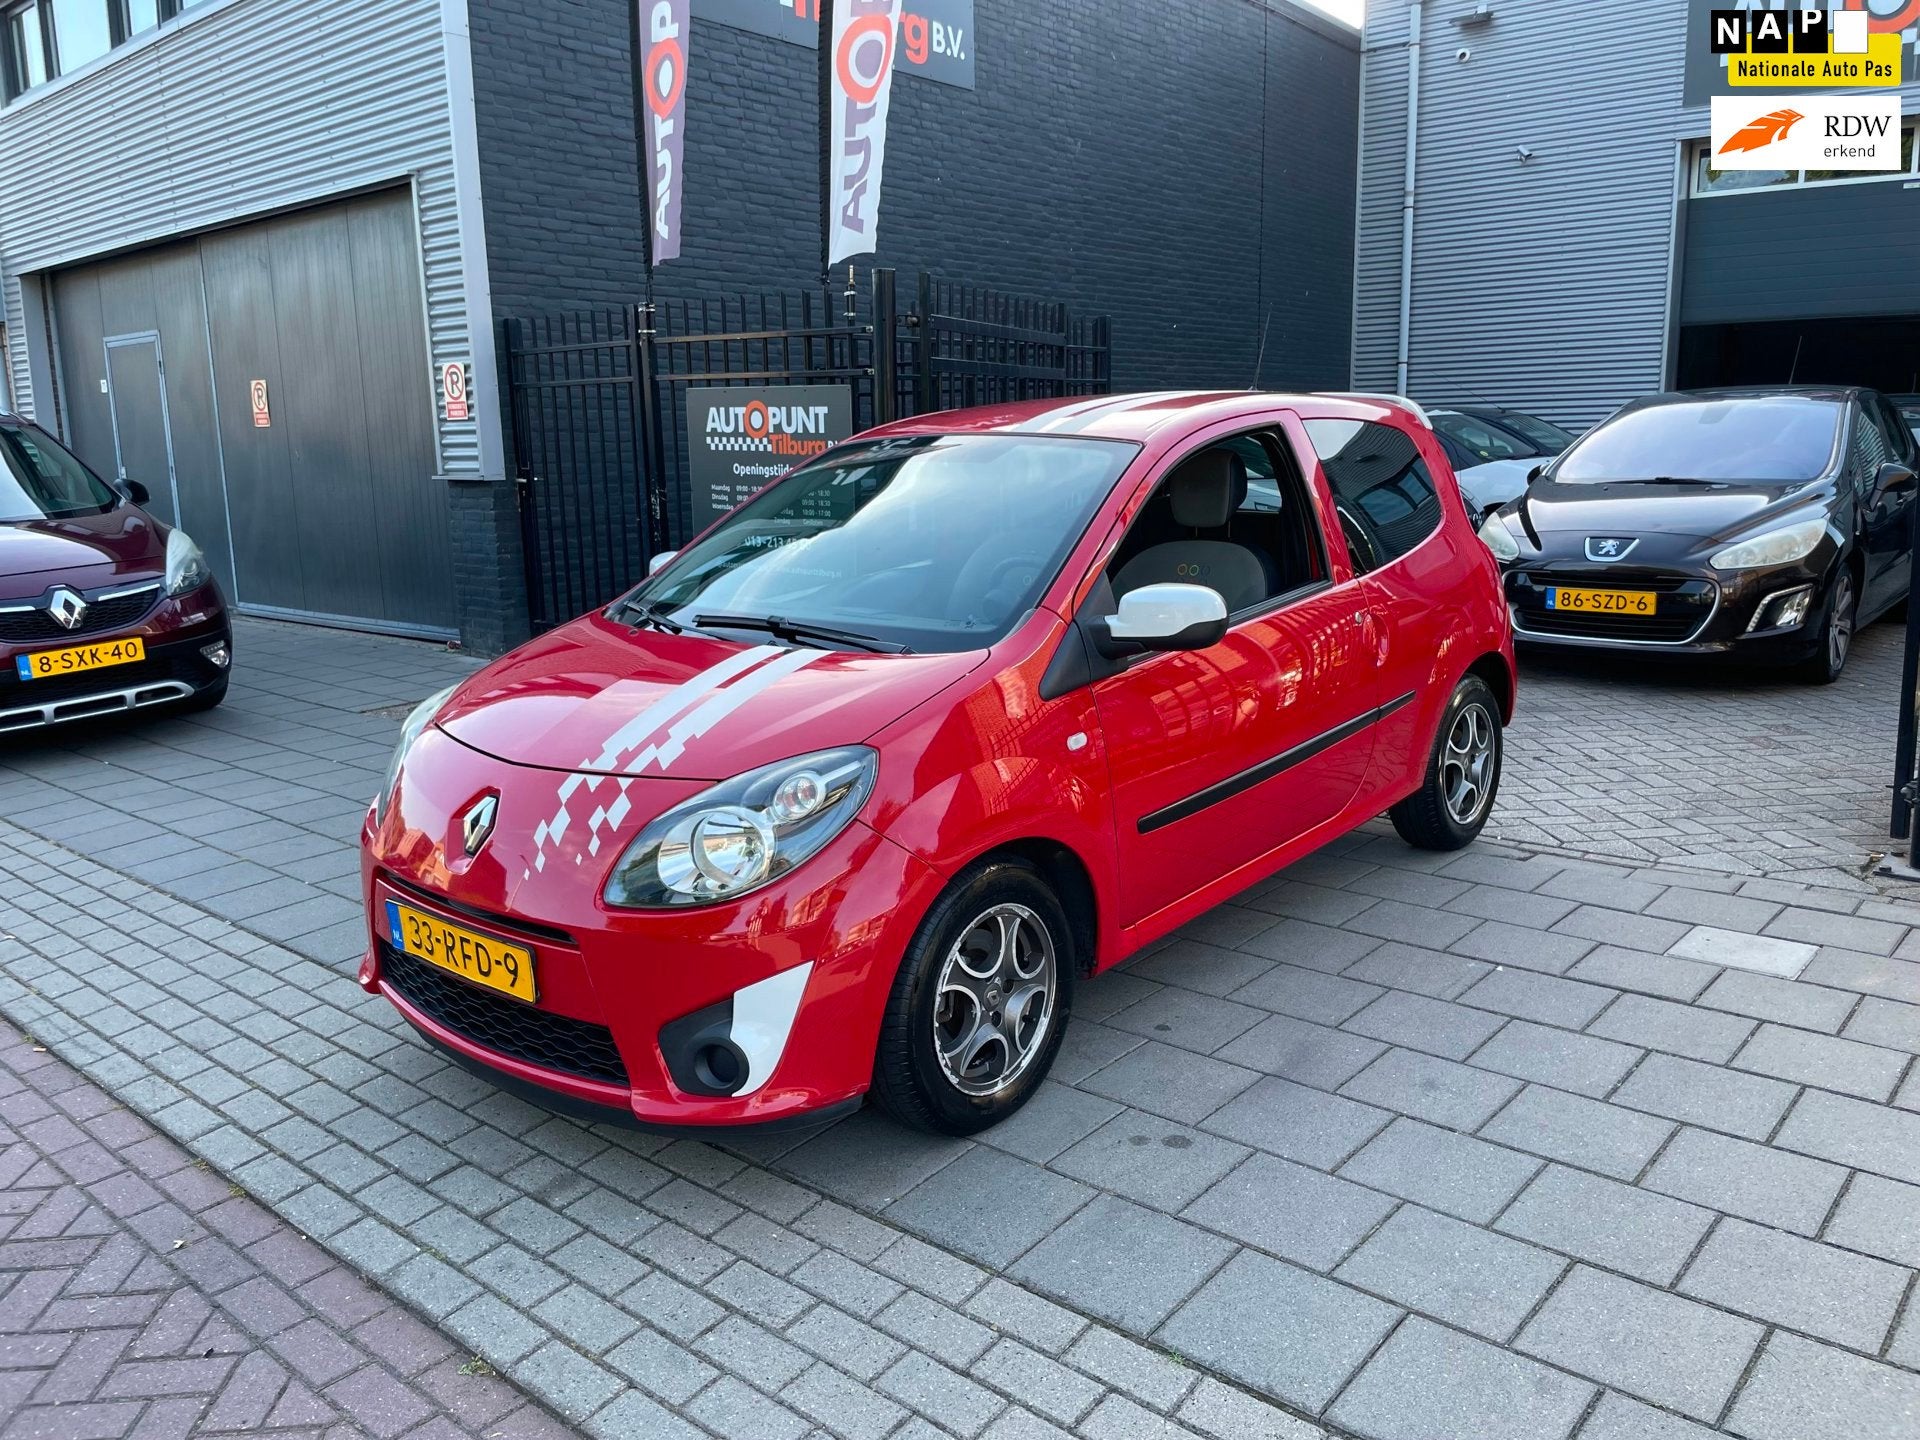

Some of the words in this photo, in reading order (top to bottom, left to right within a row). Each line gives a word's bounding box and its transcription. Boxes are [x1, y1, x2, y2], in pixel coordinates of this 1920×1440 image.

[932, 20, 965, 61] B.V.
[706, 400, 828, 439] AUTOPUNT
[711, 484, 730, 492] Maandag
[1561, 591, 1648, 611] 86-SZD-6
[39, 641, 138, 673] 8-SXK-40
[408, 915, 519, 988] 33-RFD-9
